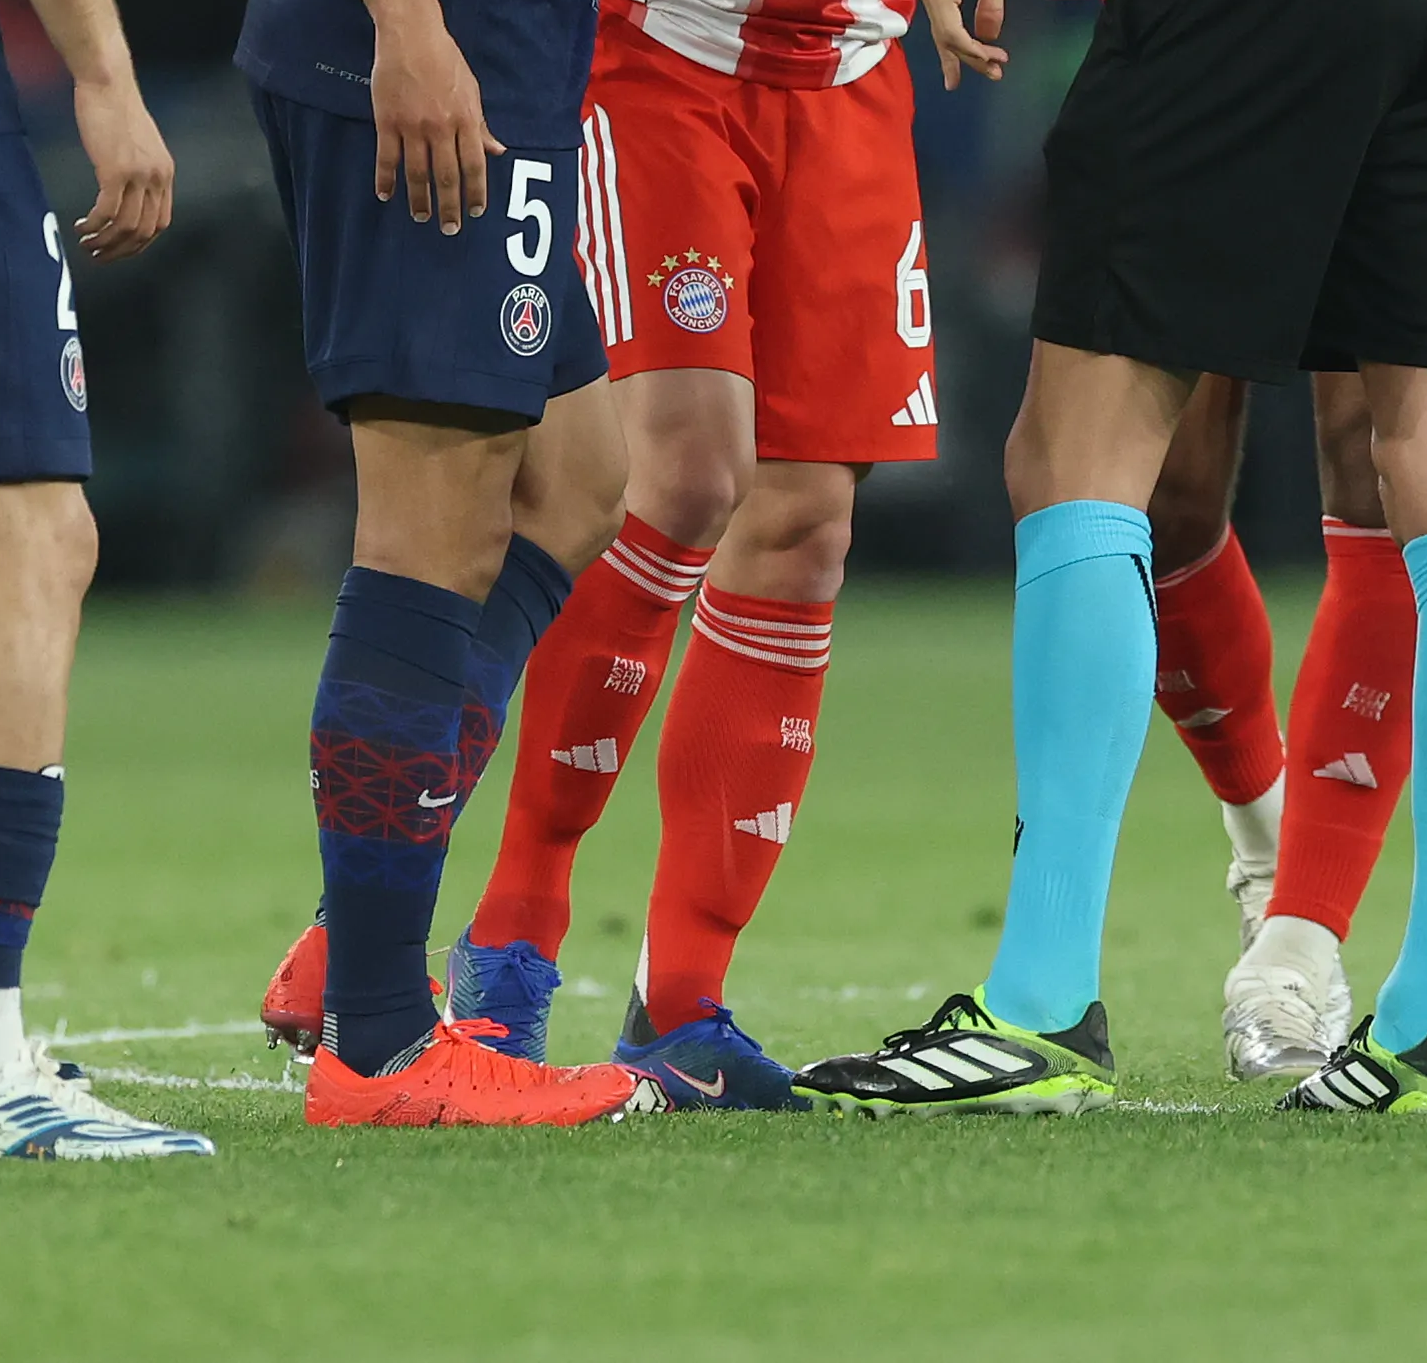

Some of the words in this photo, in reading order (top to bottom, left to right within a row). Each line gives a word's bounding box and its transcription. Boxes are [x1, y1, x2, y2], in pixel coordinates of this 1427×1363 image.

[506, 159, 552, 276] 5
[681, 273, 722, 297] BAYERN
[895, 220, 932, 348] 6
[512, 288, 545, 308] PARIS
[613, 656, 646, 672] MIA
[610, 667, 645, 684] SAN
[604, 677, 640, 695] MIA
[781, 716, 810, 730] MIA
[781, 735, 812, 753] MIA
